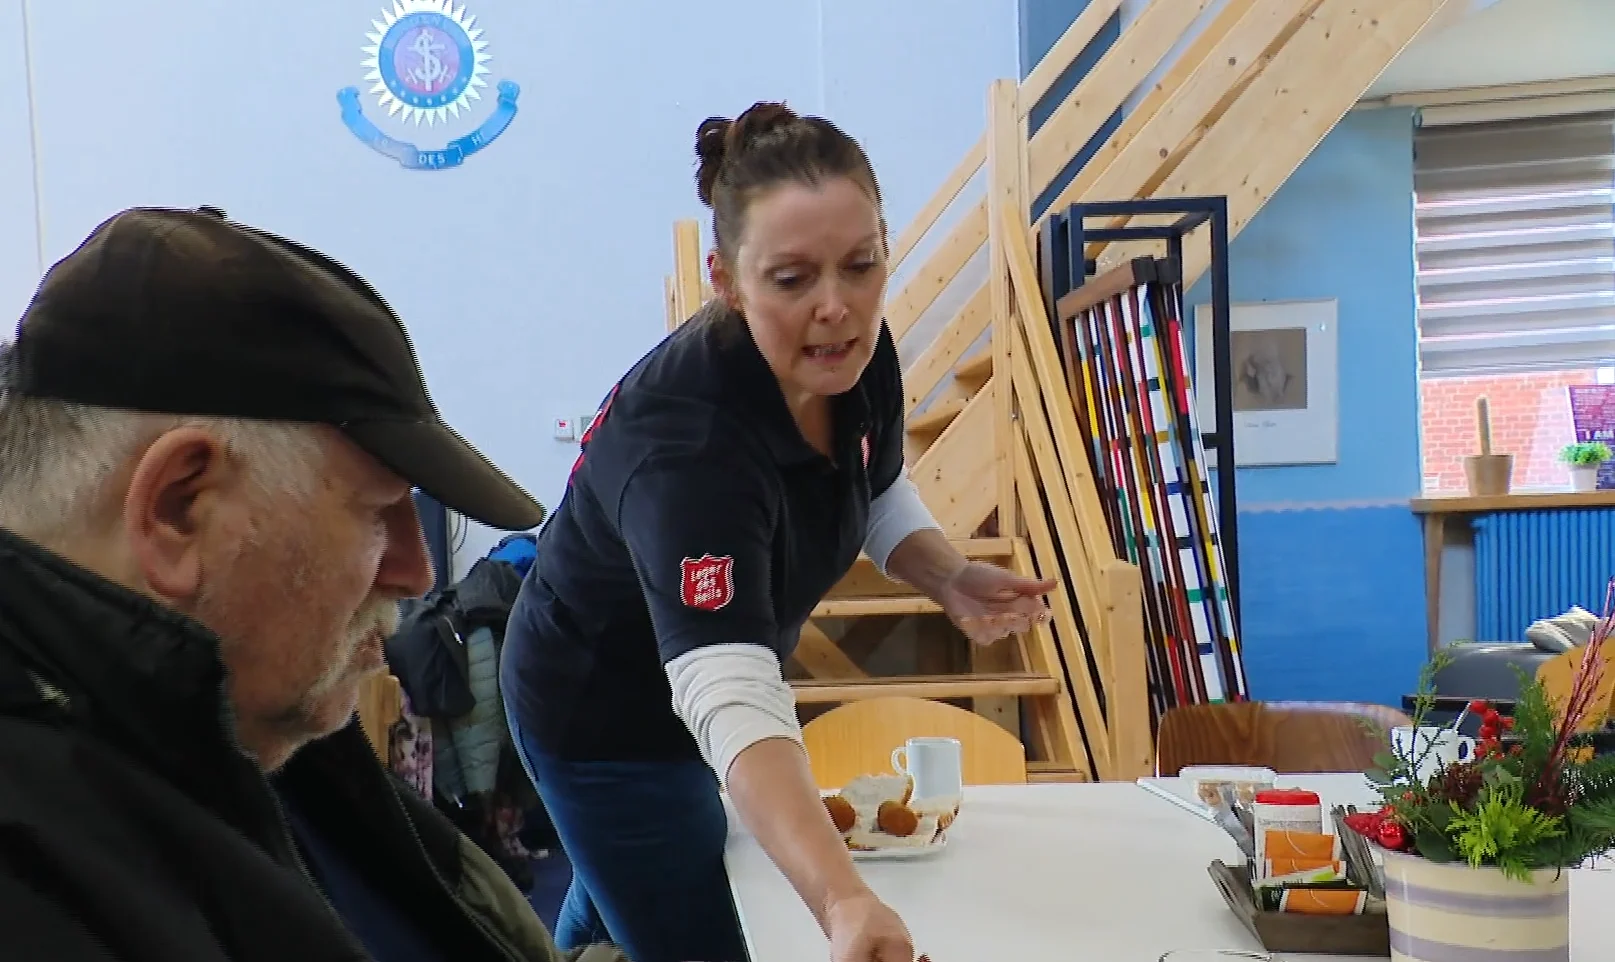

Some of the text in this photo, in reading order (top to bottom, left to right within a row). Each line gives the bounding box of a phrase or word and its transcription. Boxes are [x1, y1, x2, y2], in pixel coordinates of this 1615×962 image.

[418, 153, 446, 165] DES
[690, 564, 722, 582] Leger
[696, 577, 716, 592] des
[693, 588, 722, 606] Heils
